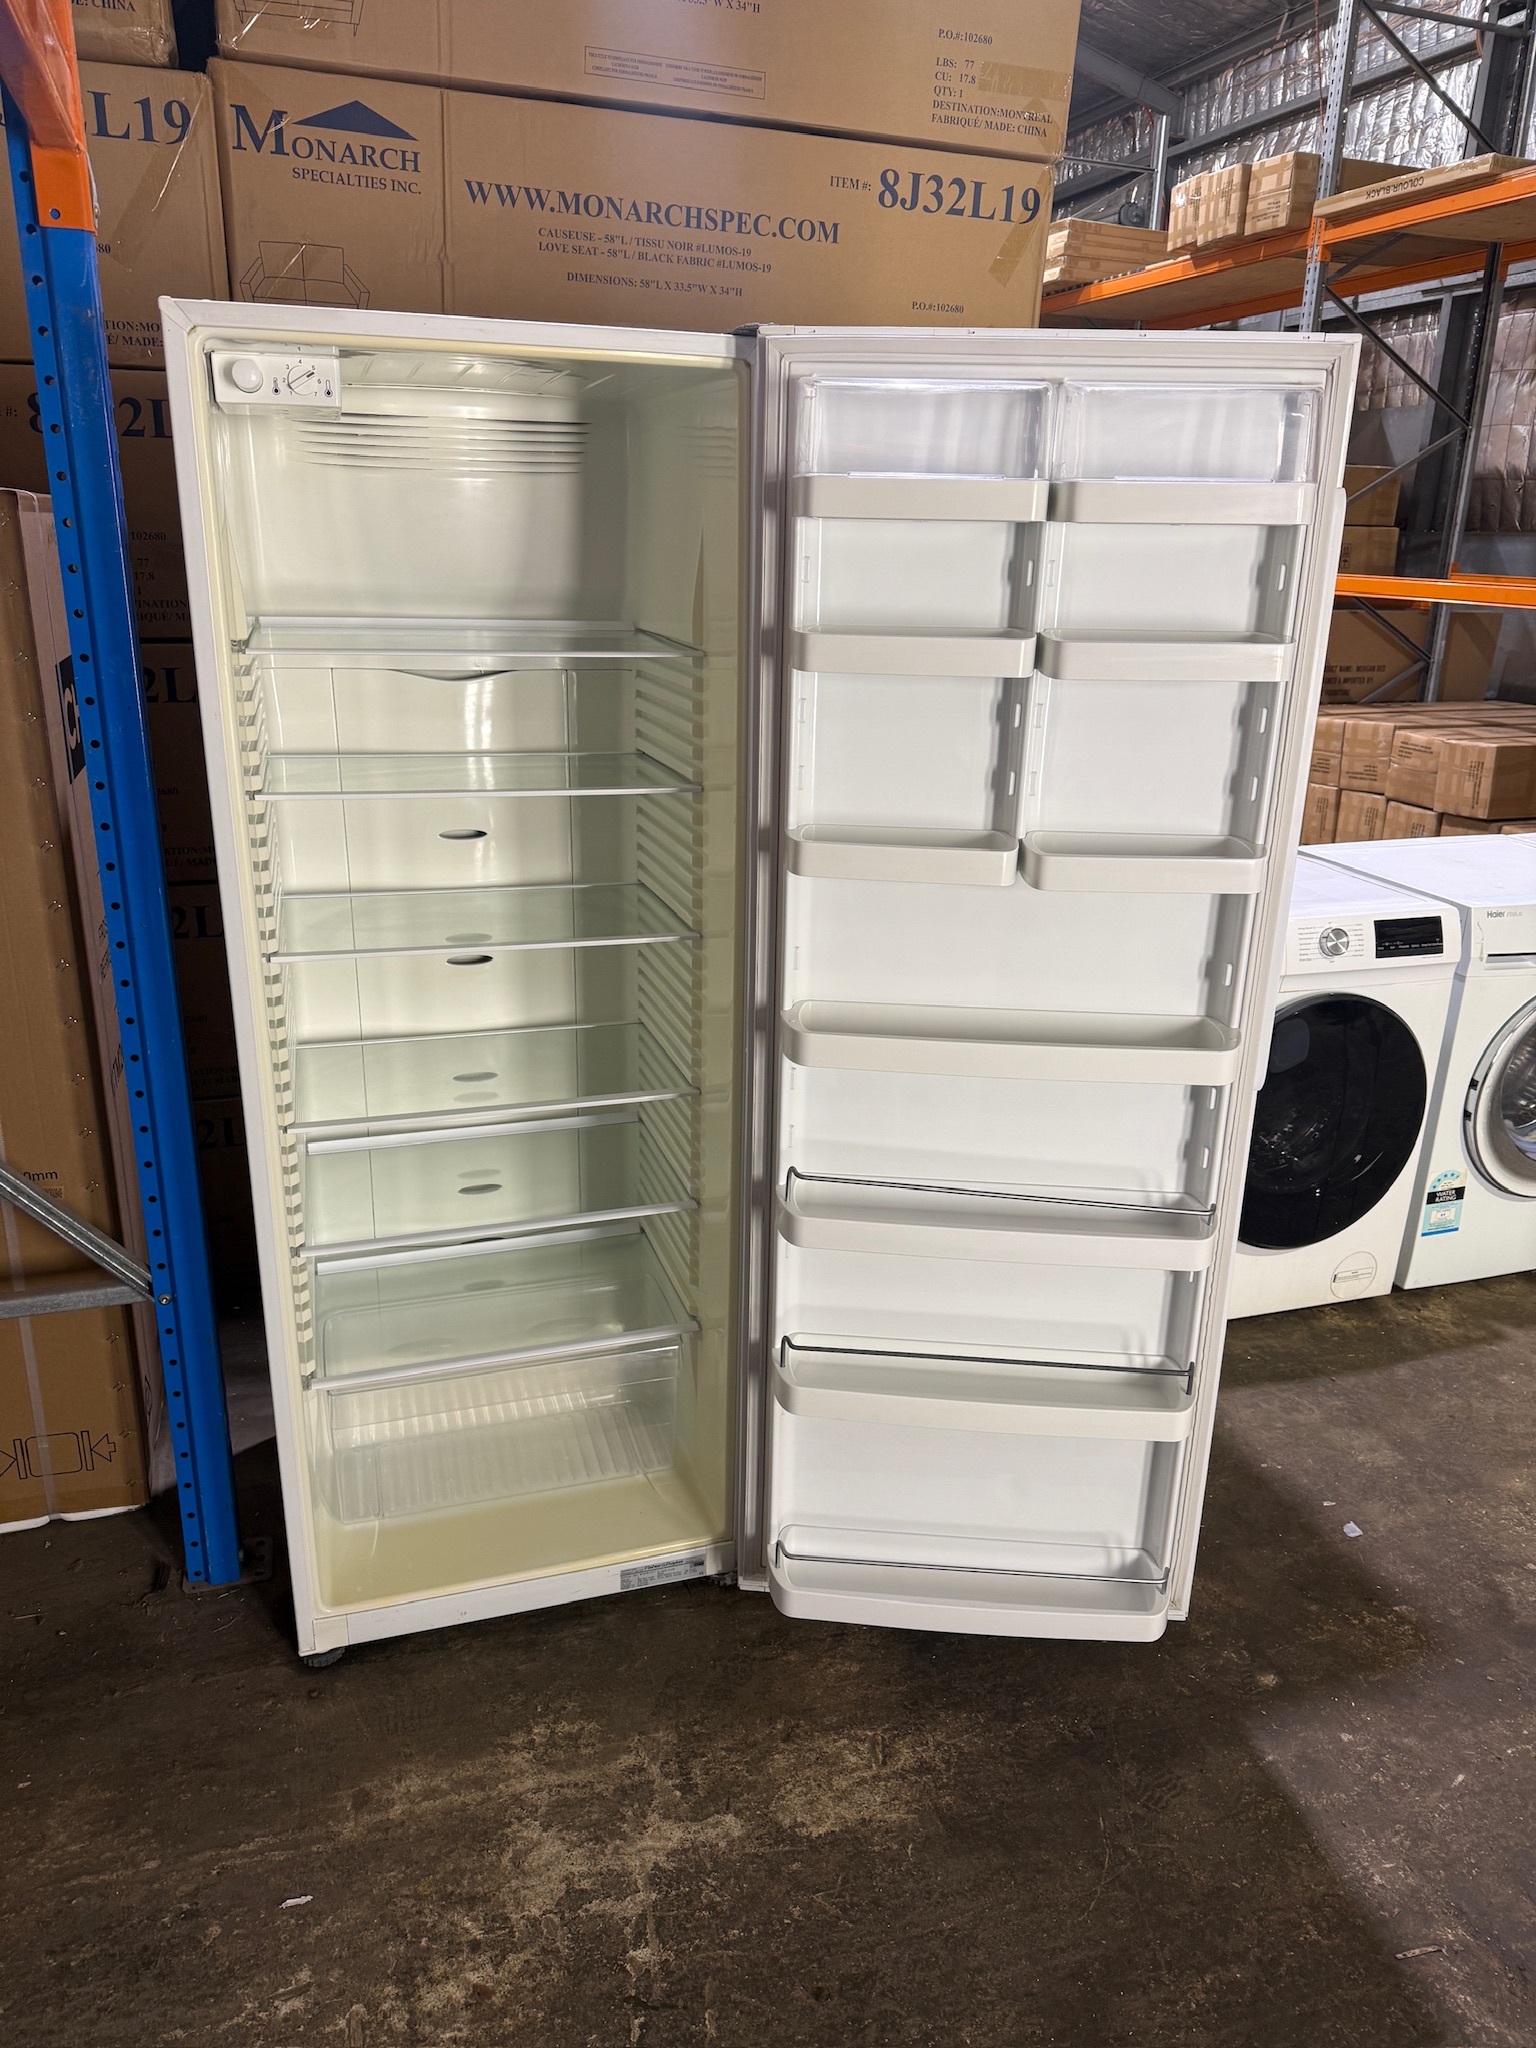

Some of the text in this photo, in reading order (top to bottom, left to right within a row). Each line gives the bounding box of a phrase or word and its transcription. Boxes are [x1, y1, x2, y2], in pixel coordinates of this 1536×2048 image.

[736, 1, 760, 13] 34"H
[938, 28, 993, 45] P.O.#:102680
[936, 57, 975, 70] LBS: 77
[934, 71, 976, 85] CU: 17.8
[933, 85, 963, 98] QTY: 1
[84, 90, 191, 145] L19
[984, 120, 1015, 133] MADE:
[1017, 124, 1047, 138] CHINA
[229, 104, 421, 173] MONARCH
[292, 167, 422, 195] SPECIALTIES INC.
[1365, 176, 1425, 200] COLOUR:BLACK
[829, 168, 1041, 225] ITEM #: 8J32L19
[464, 179, 841, 244] WWW.MONARCHSPEC.COM
[96, 243, 111, 254] 80
[538, 227, 596, 242] CAUSEUSE
[604, 233, 628, 245] 58"L
[635, 237, 665, 249] TISSU
[667, 240, 693, 251] NOIR
[695, 244, 752, 257] #LUMOS-19
[538, 242, 569, 254] LOVE
[571, 245, 599, 256] SEAT
[606, 248, 631, 260] 58"L
[638, 252, 675, 264] BLACK
[676, 256, 715, 268] FABRIC
[716, 260, 772, 274] #LUMOS-19
[567, 271, 743, 297] DIMENSIONS: 58"L X 33.5"W X 34"H
[911, 301, 964, 314] P.O.#:102680
[104, 320, 162, 332] TION:MO
[1436, 1189, 1456, 1197] WATER
